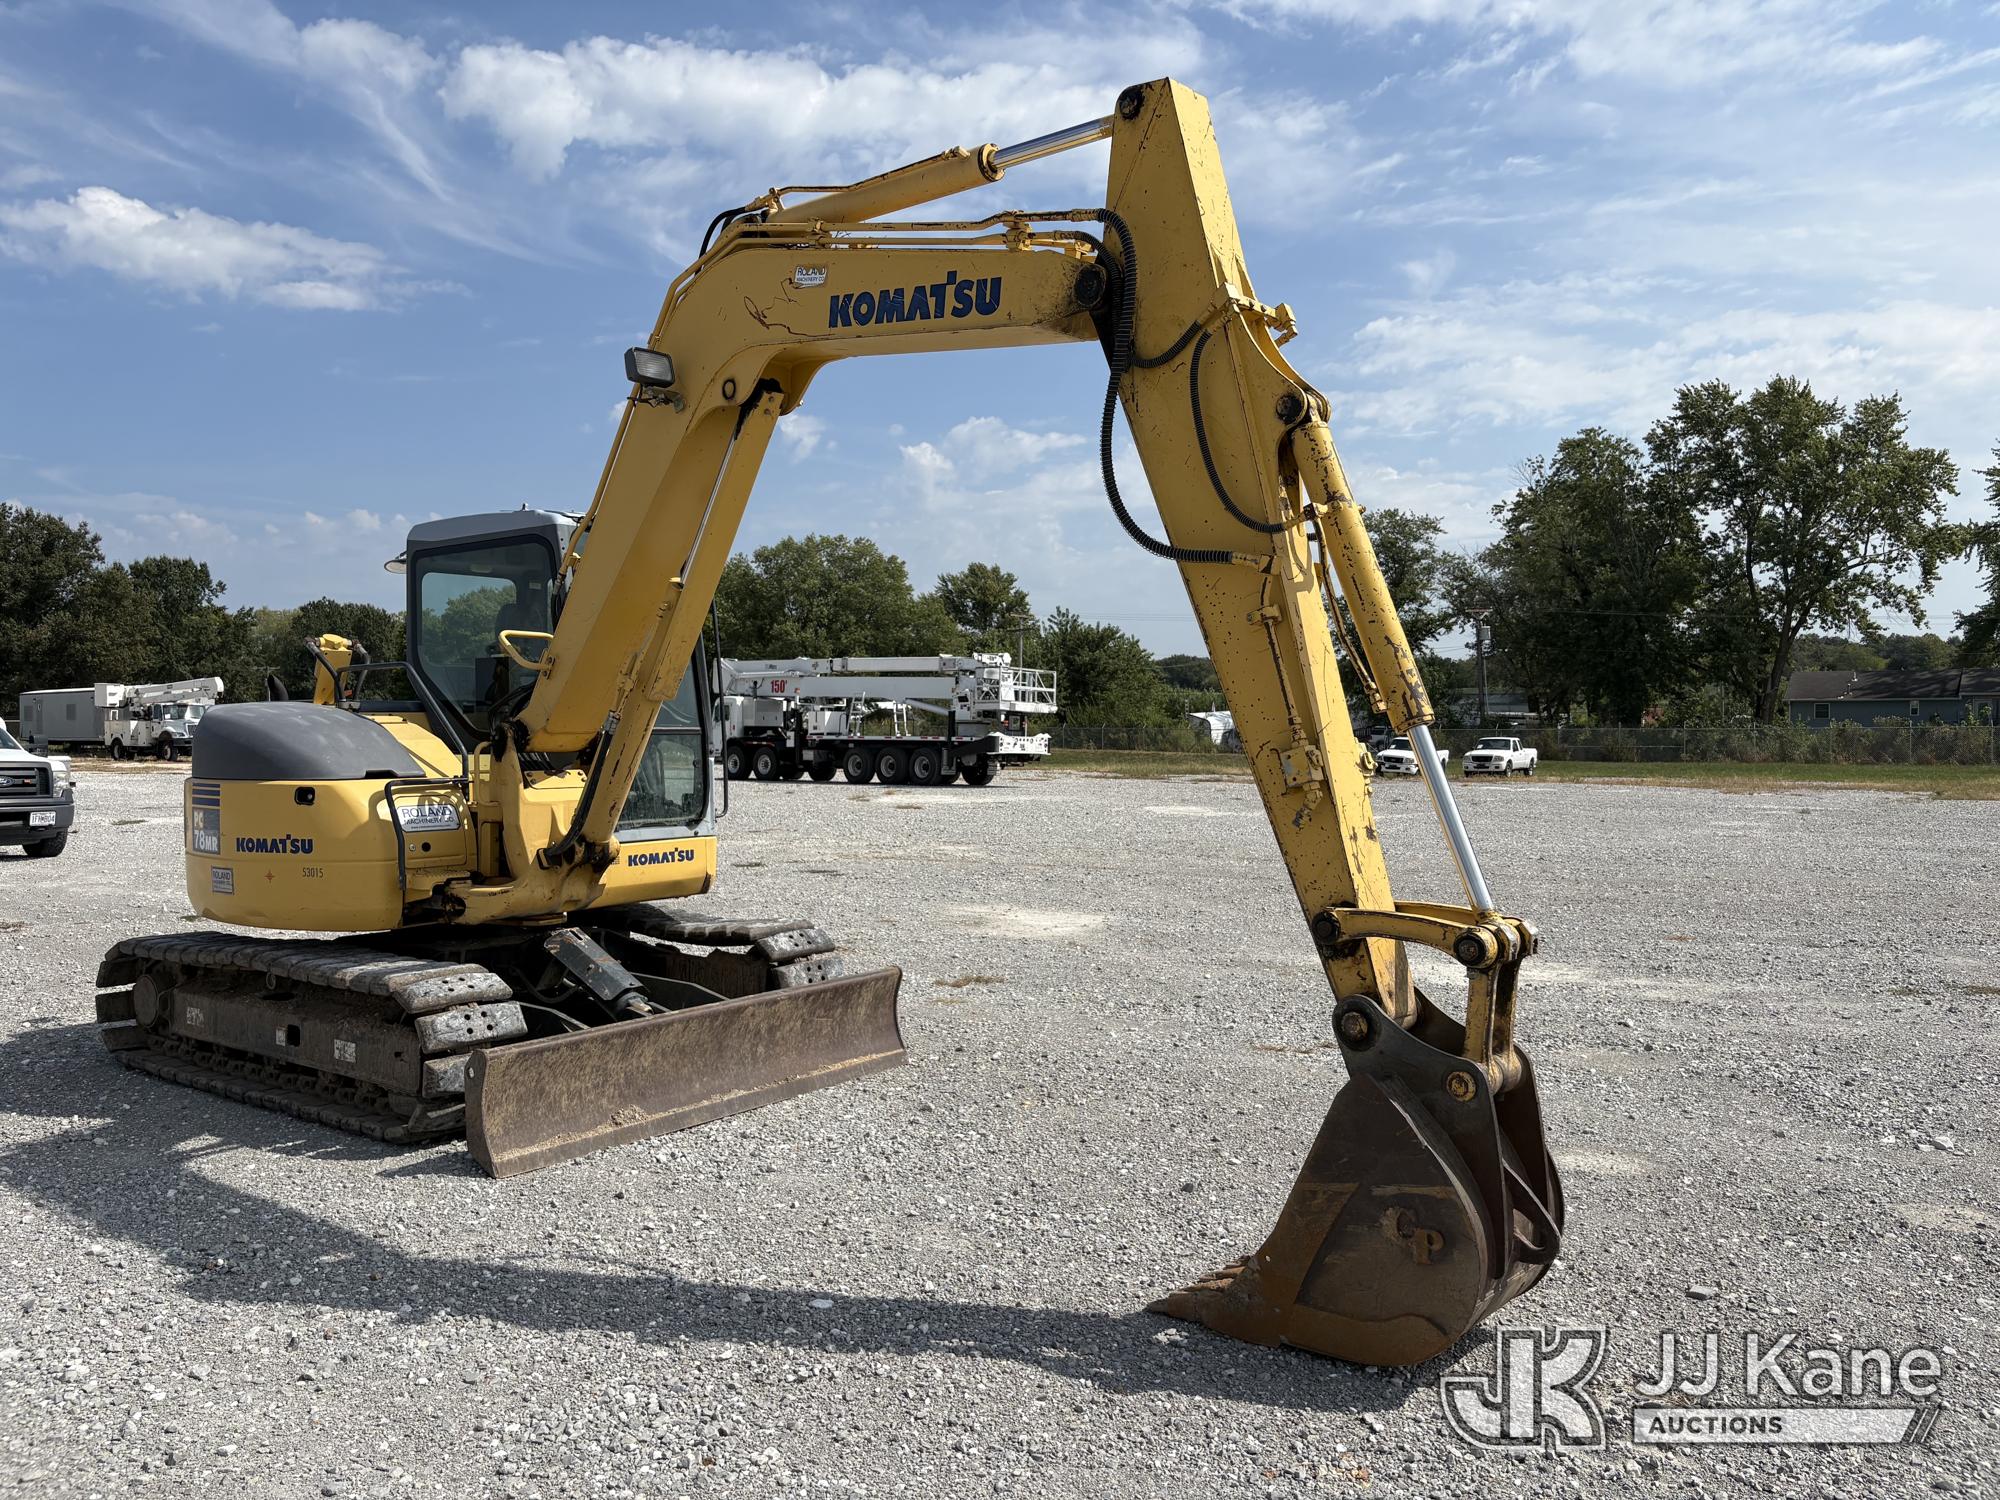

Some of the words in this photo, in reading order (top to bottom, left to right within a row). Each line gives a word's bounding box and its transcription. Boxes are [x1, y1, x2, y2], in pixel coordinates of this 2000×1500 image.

[829, 270, 1002, 329] KOMATSU
[193, 811, 204, 828] PC
[401, 806, 453, 819] ROLAND
[236, 834, 314, 855] KOMATSU
[628, 847, 695, 867] KOMATSU
[302, 867, 324, 879] 53015
